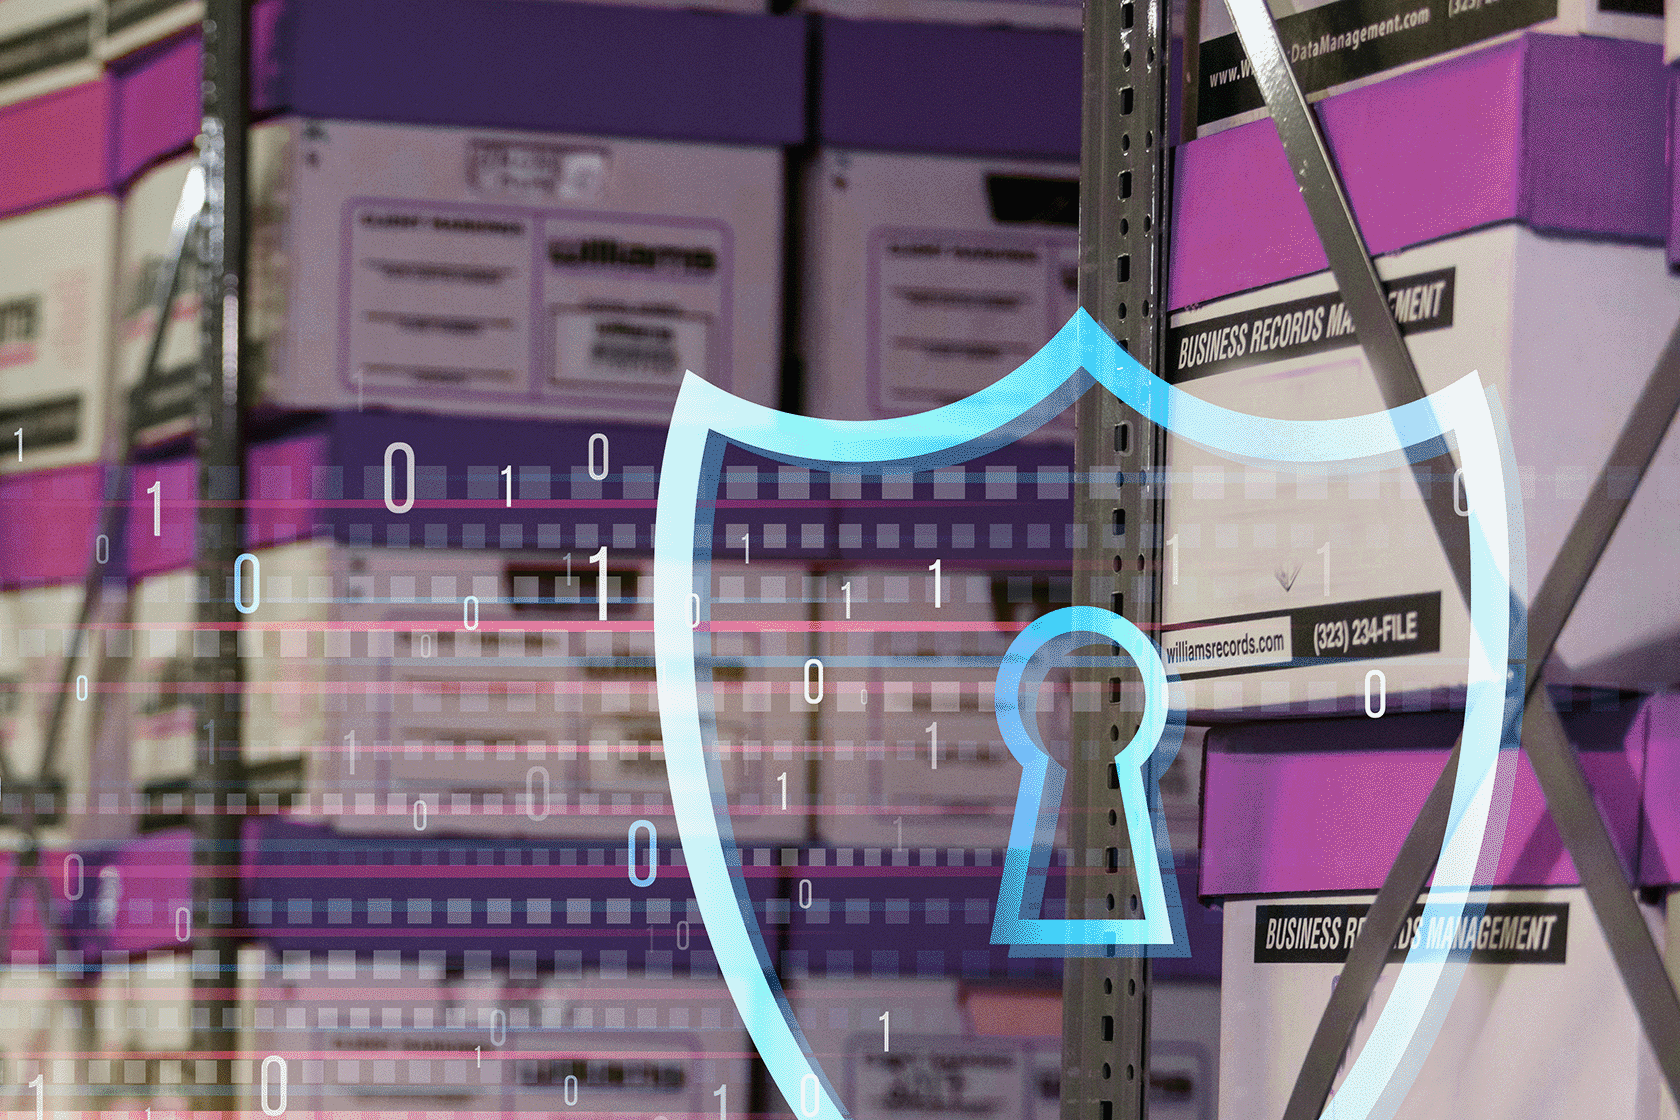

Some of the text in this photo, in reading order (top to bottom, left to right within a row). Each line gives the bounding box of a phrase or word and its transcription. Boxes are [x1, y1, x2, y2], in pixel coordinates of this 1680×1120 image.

[1178, 320, 1249, 370] BUSINESS
[1249, 305, 1325, 354] RECORDS
[1166, 611, 1418, 664] williamsrecords.com (323) 234-FILE
[1266, 917, 1342, 950] BUSINESS
[1425, 915, 1558, 951] MANAGEMENT
